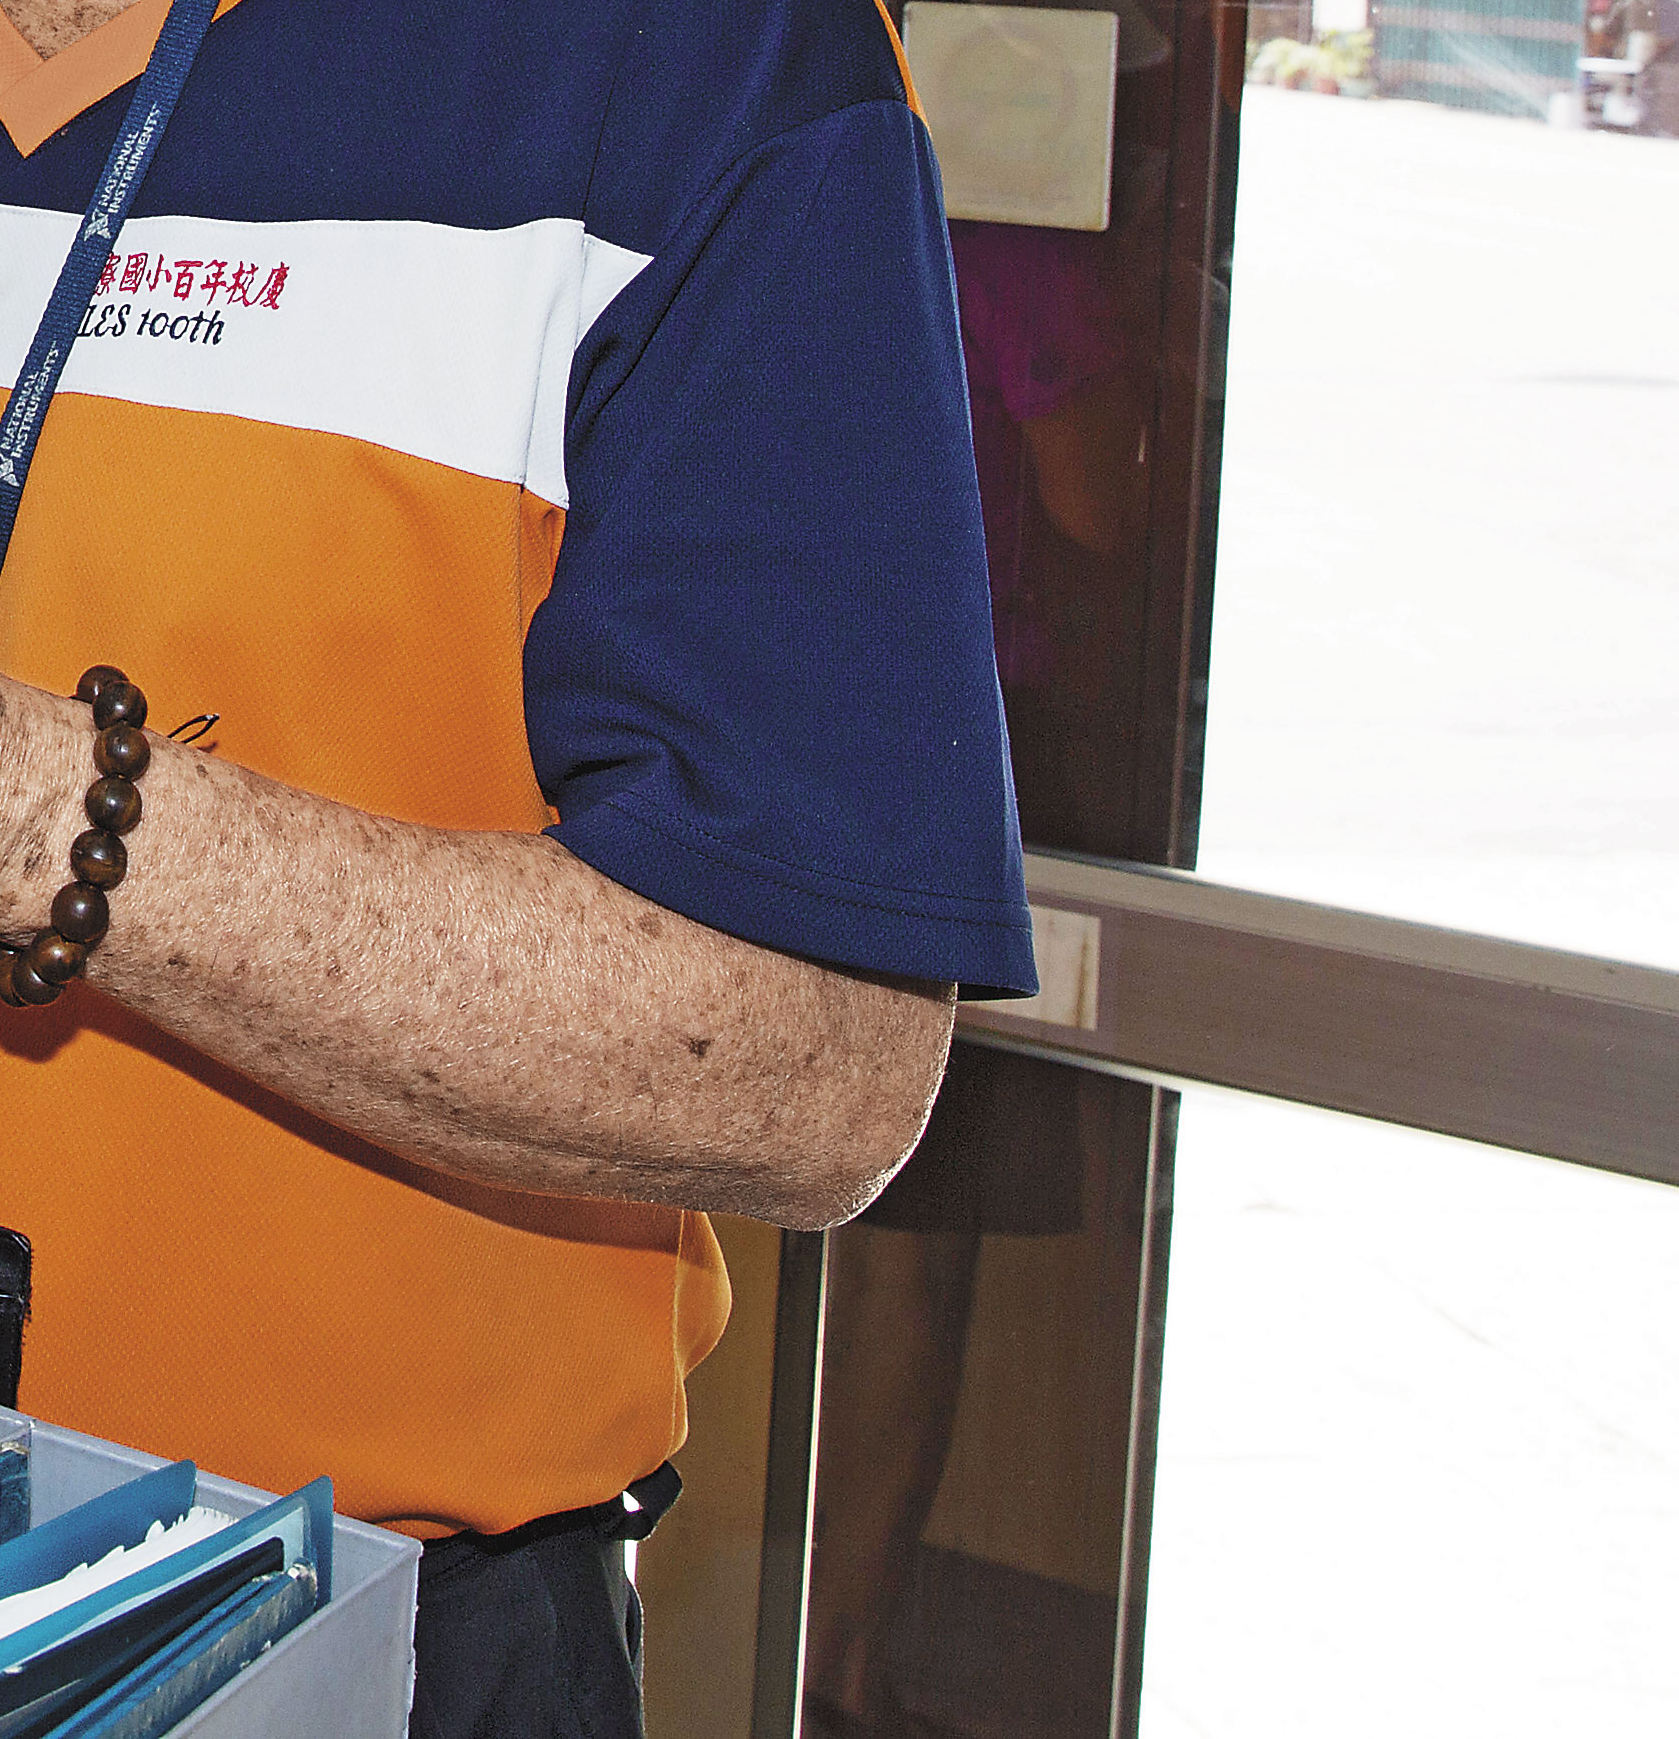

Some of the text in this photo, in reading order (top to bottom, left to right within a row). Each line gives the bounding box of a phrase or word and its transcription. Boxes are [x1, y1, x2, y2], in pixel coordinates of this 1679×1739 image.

[100, 130, 140, 208] NATIONAL
[107, 106, 159, 214] INSTRUMENTS
[137, 309, 225, 345] 100th
[0, 371, 40, 451] NATIONAL
[10, 345, 60, 458] INSTRUMENTS
